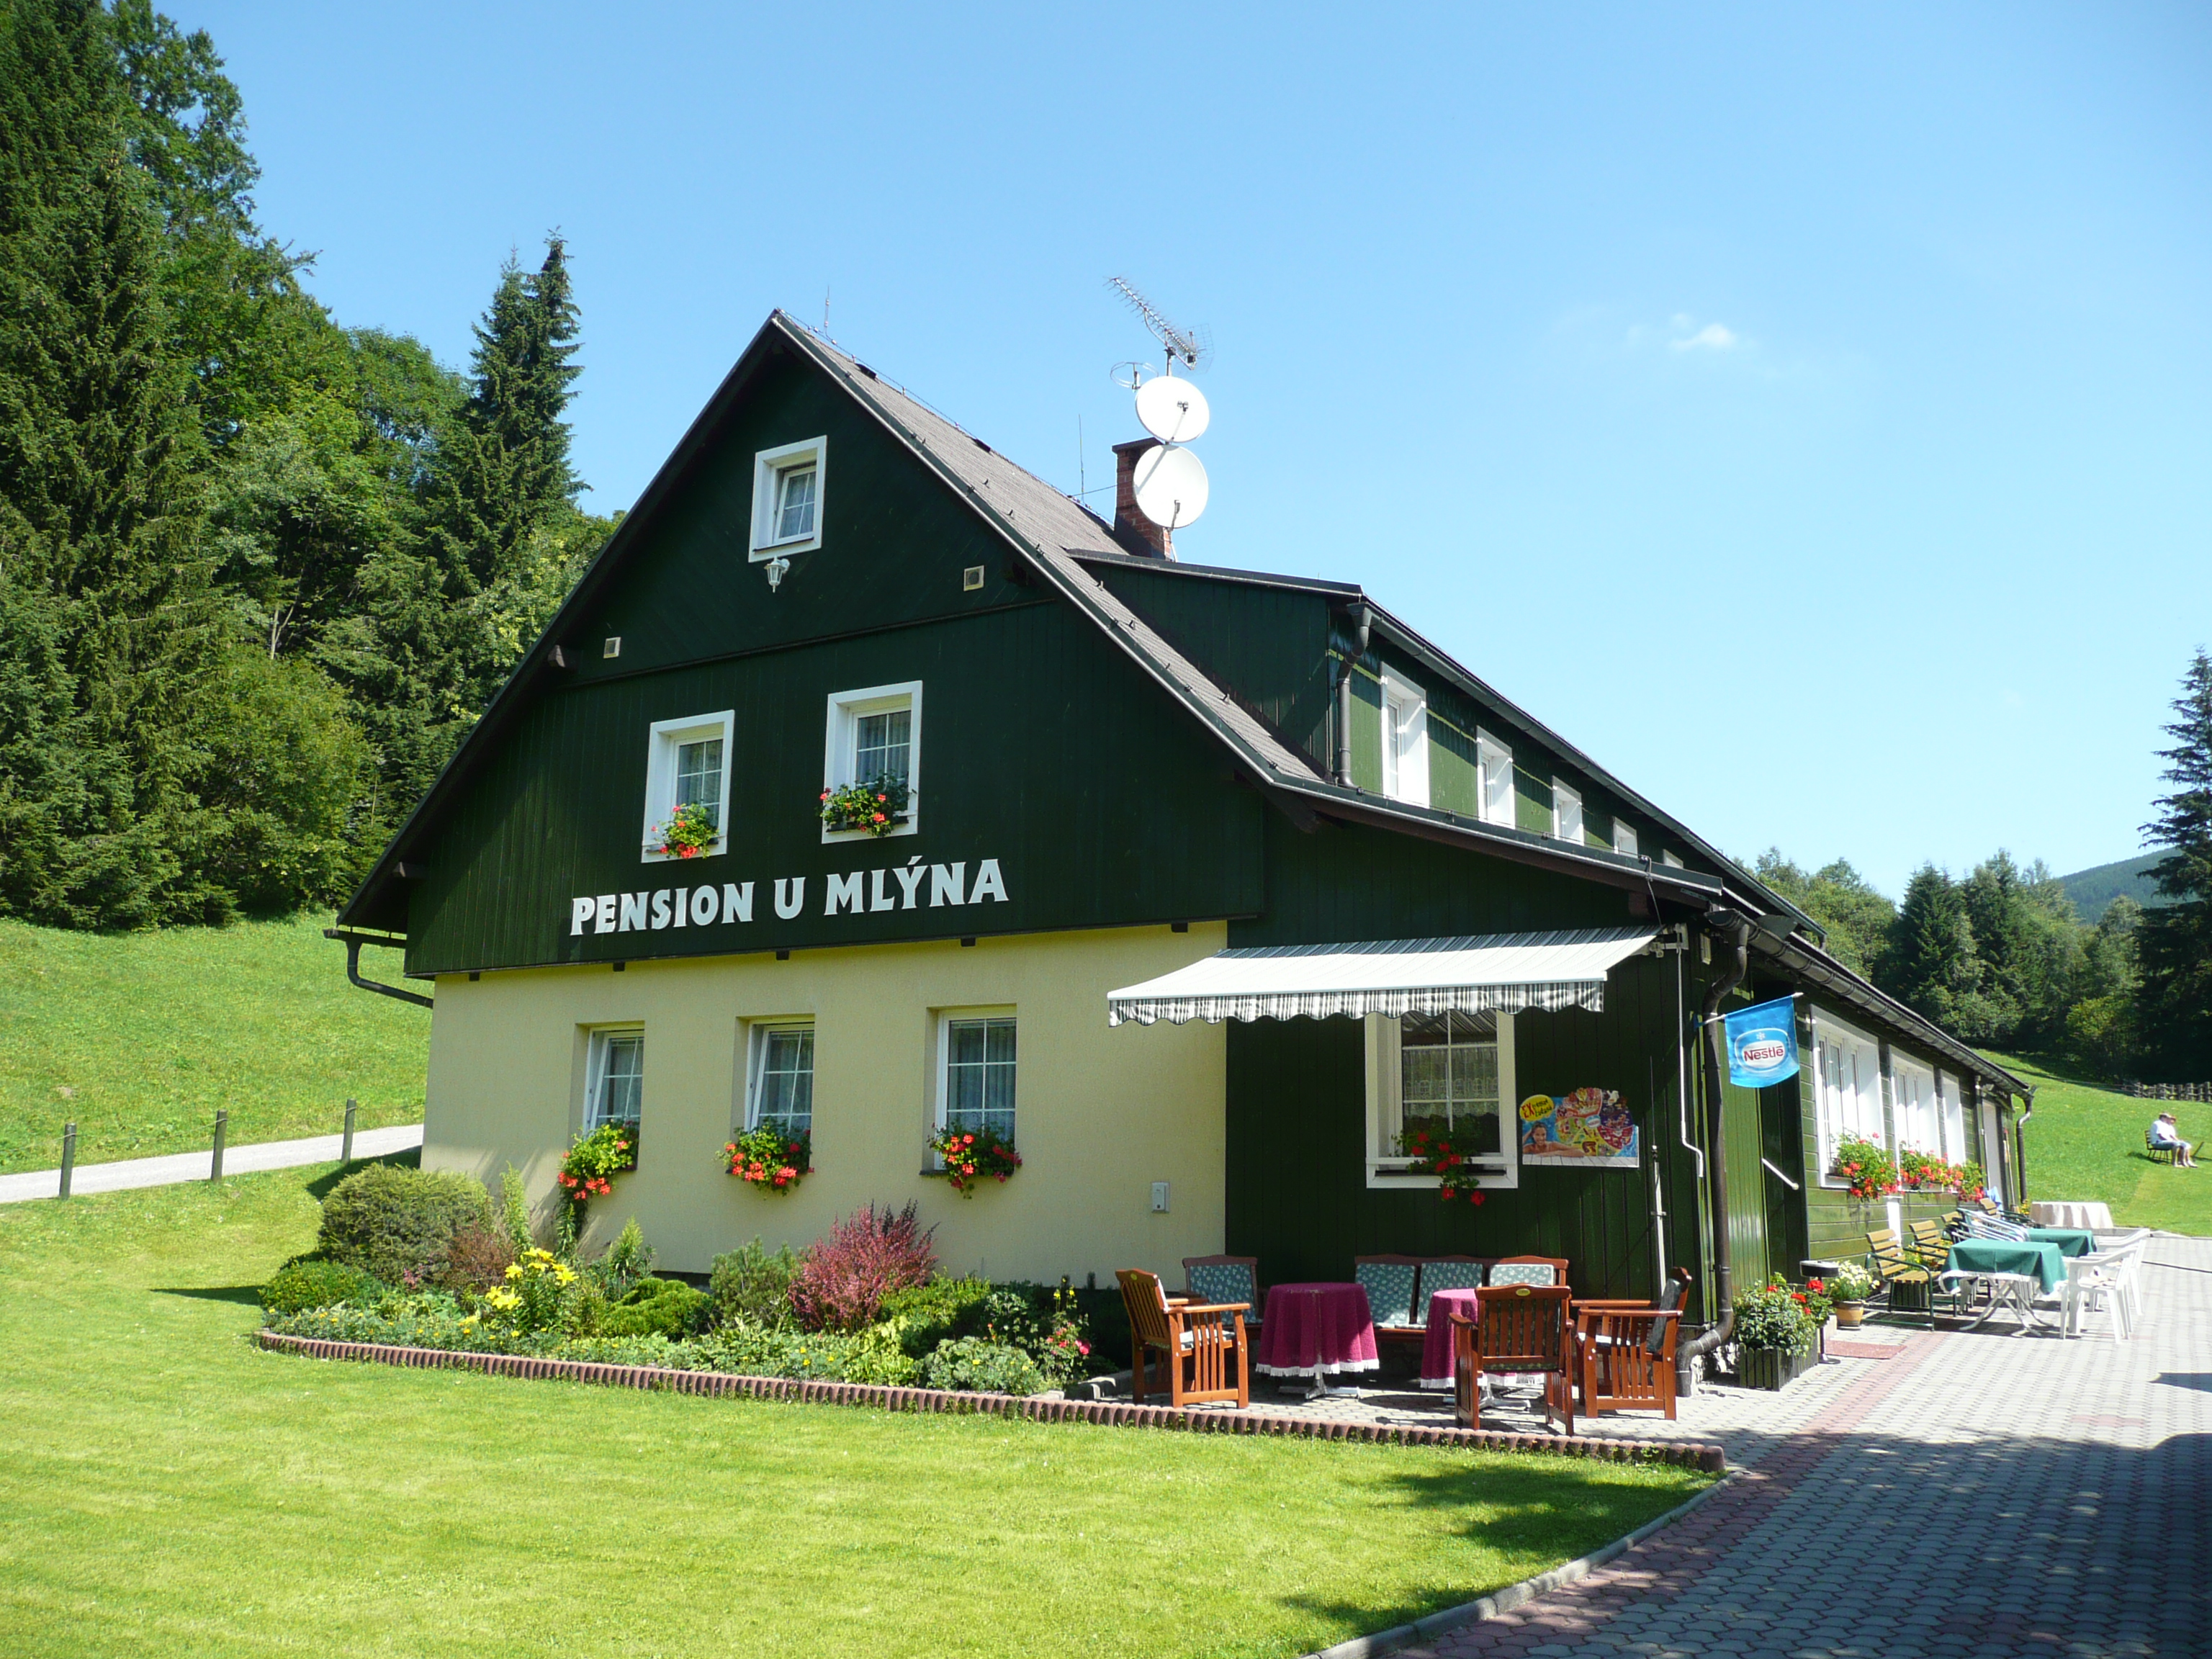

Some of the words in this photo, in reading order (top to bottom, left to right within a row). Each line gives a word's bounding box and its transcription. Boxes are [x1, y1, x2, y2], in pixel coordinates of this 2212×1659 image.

[570, 881, 755, 936] PENSION
[774, 876, 806, 920] U
[824, 855, 1010, 916] MLÝNA
